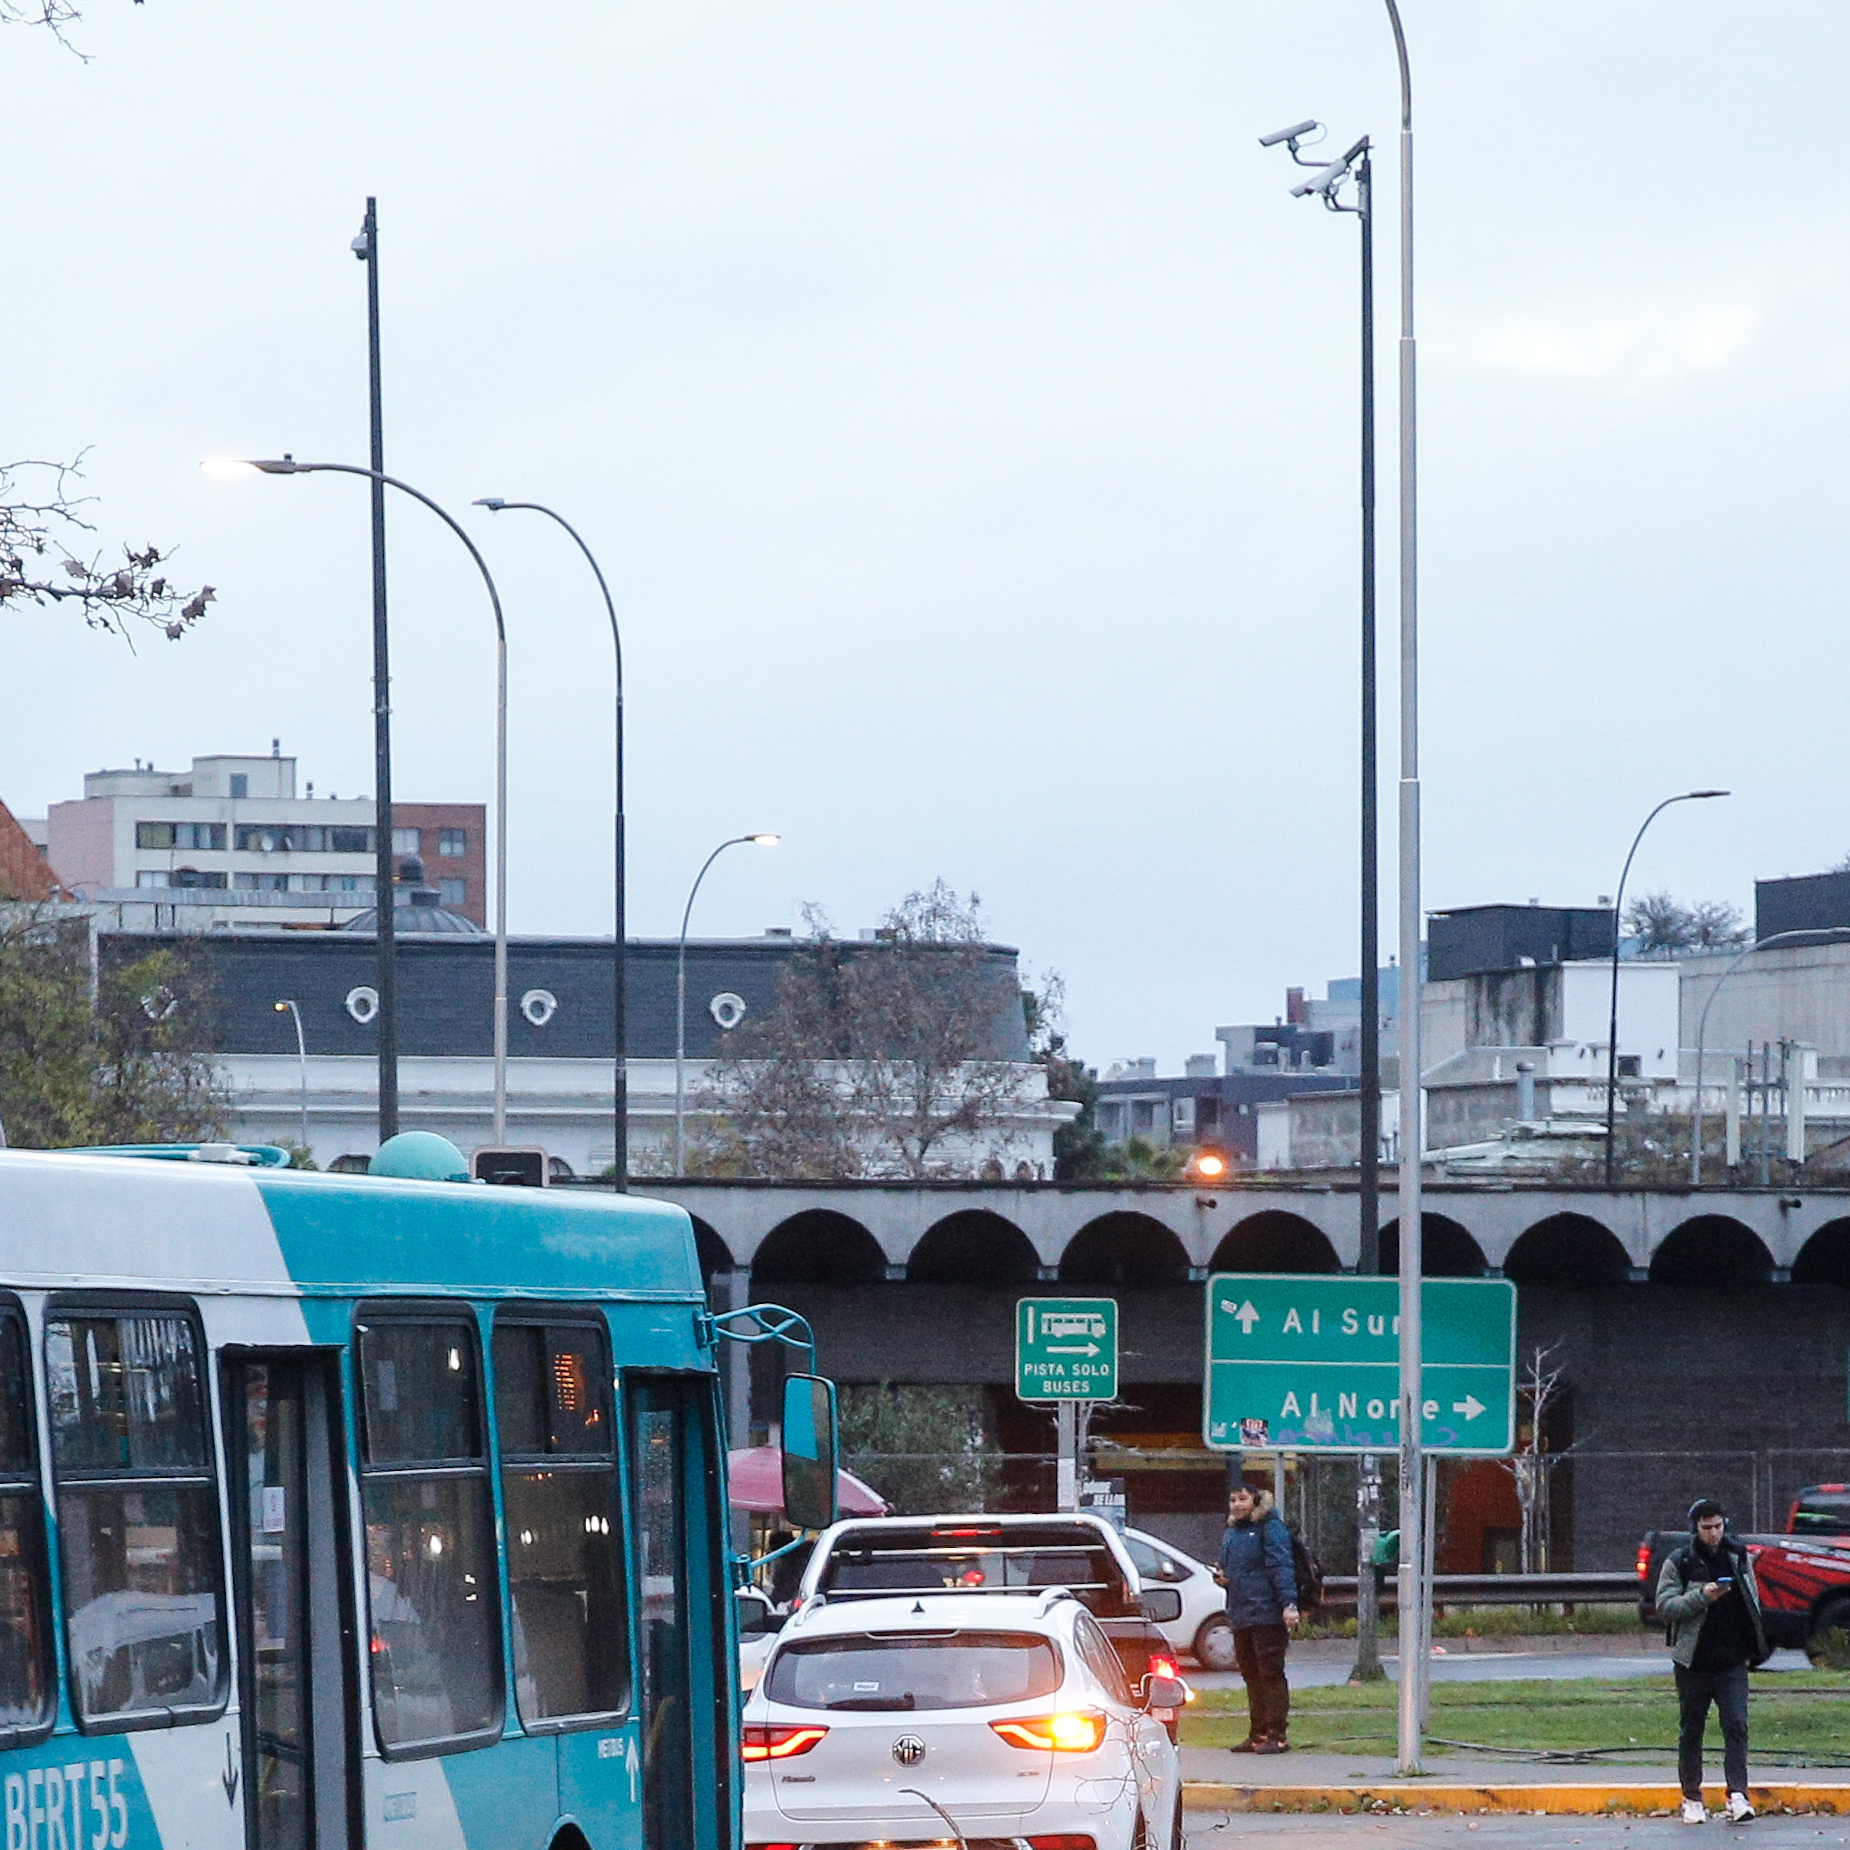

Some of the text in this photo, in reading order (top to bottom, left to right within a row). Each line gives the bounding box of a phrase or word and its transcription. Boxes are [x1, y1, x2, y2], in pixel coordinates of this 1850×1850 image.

[1282, 1307, 1320, 1335] Al
[1024, 1363, 1110, 1376] PISTA SOLO
[1042, 1380, 1090, 1393] BUSES
[1280, 1391, 1440, 1419] Al Nore
